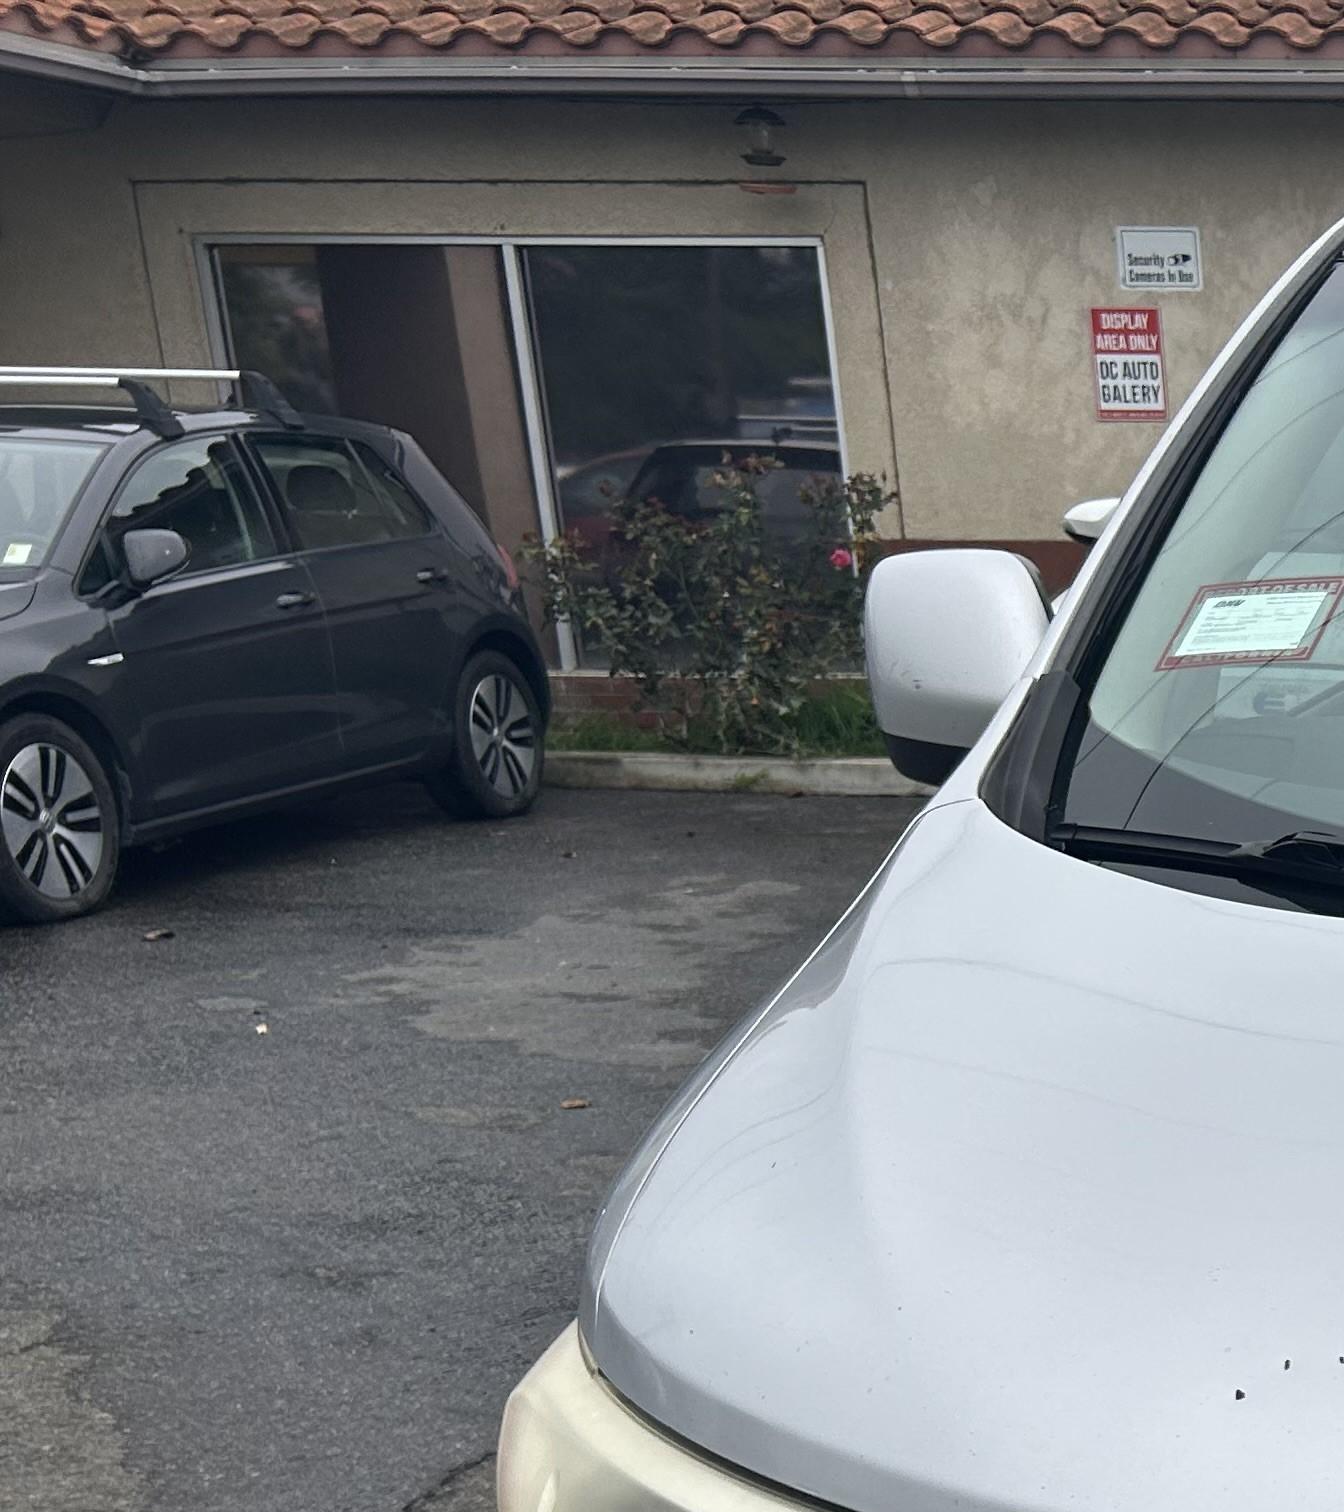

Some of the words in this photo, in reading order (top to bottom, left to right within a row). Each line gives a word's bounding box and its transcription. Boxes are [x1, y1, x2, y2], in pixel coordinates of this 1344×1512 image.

[1128, 253, 1165, 269] Security
[1129, 270, 1165, 283] Cameras
[1179, 271, 1194, 283] Use
[1101, 313, 1149, 330] DISPLAY
[1096, 335, 1127, 350] AREA
[1129, 334, 1159, 351] ONLY
[1100, 361, 1119, 380] OC
[1123, 361, 1159, 380] AUTO
[1101, 385, 1160, 404] GALERY
